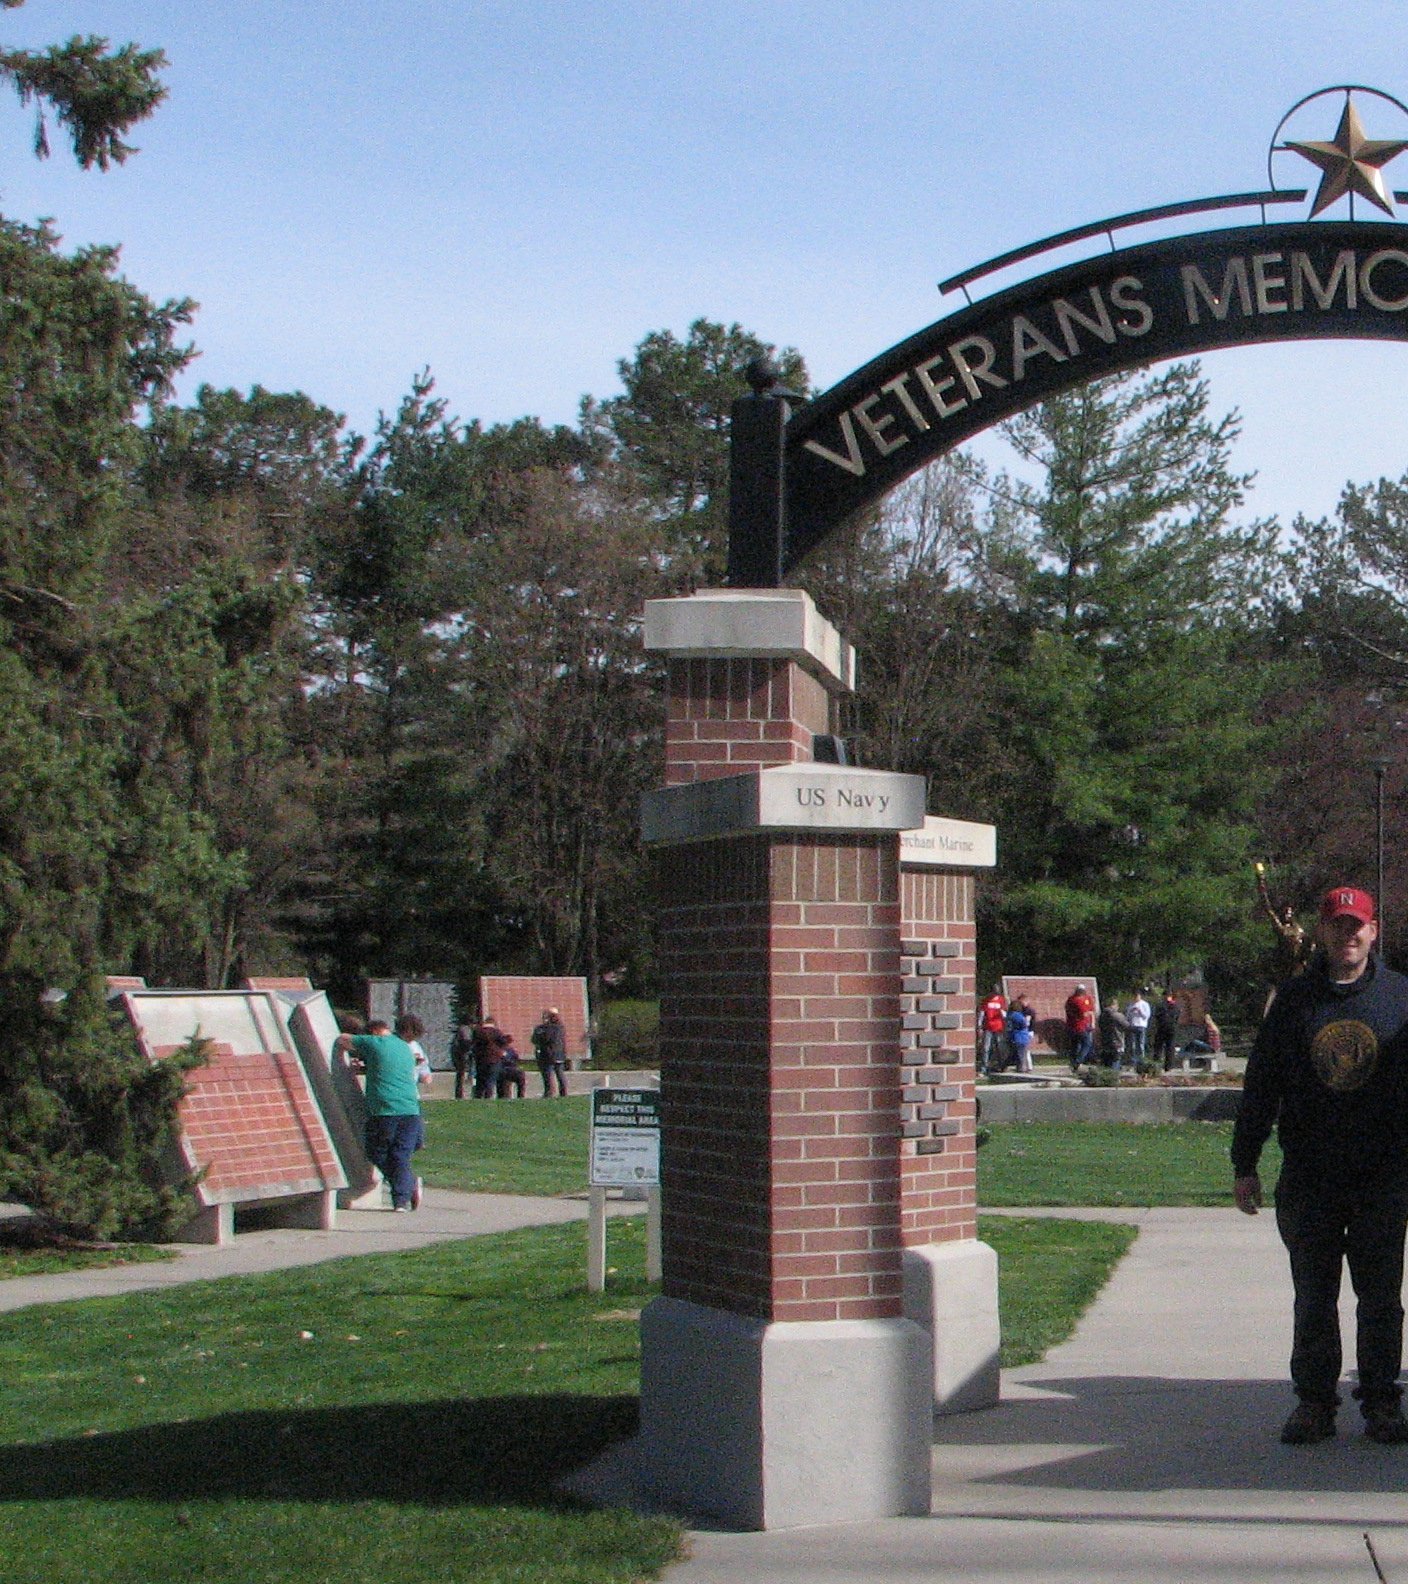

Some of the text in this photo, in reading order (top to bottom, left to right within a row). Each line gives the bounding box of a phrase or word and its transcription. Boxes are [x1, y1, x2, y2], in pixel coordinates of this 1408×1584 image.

[803, 274, 1153, 481] VETERANS
[797, 788, 891, 813] US Navy
[939, 834, 975, 853] Marine
[1340, 893, 1354, 906] N
[613, 1093, 642, 1103] PLEASE
